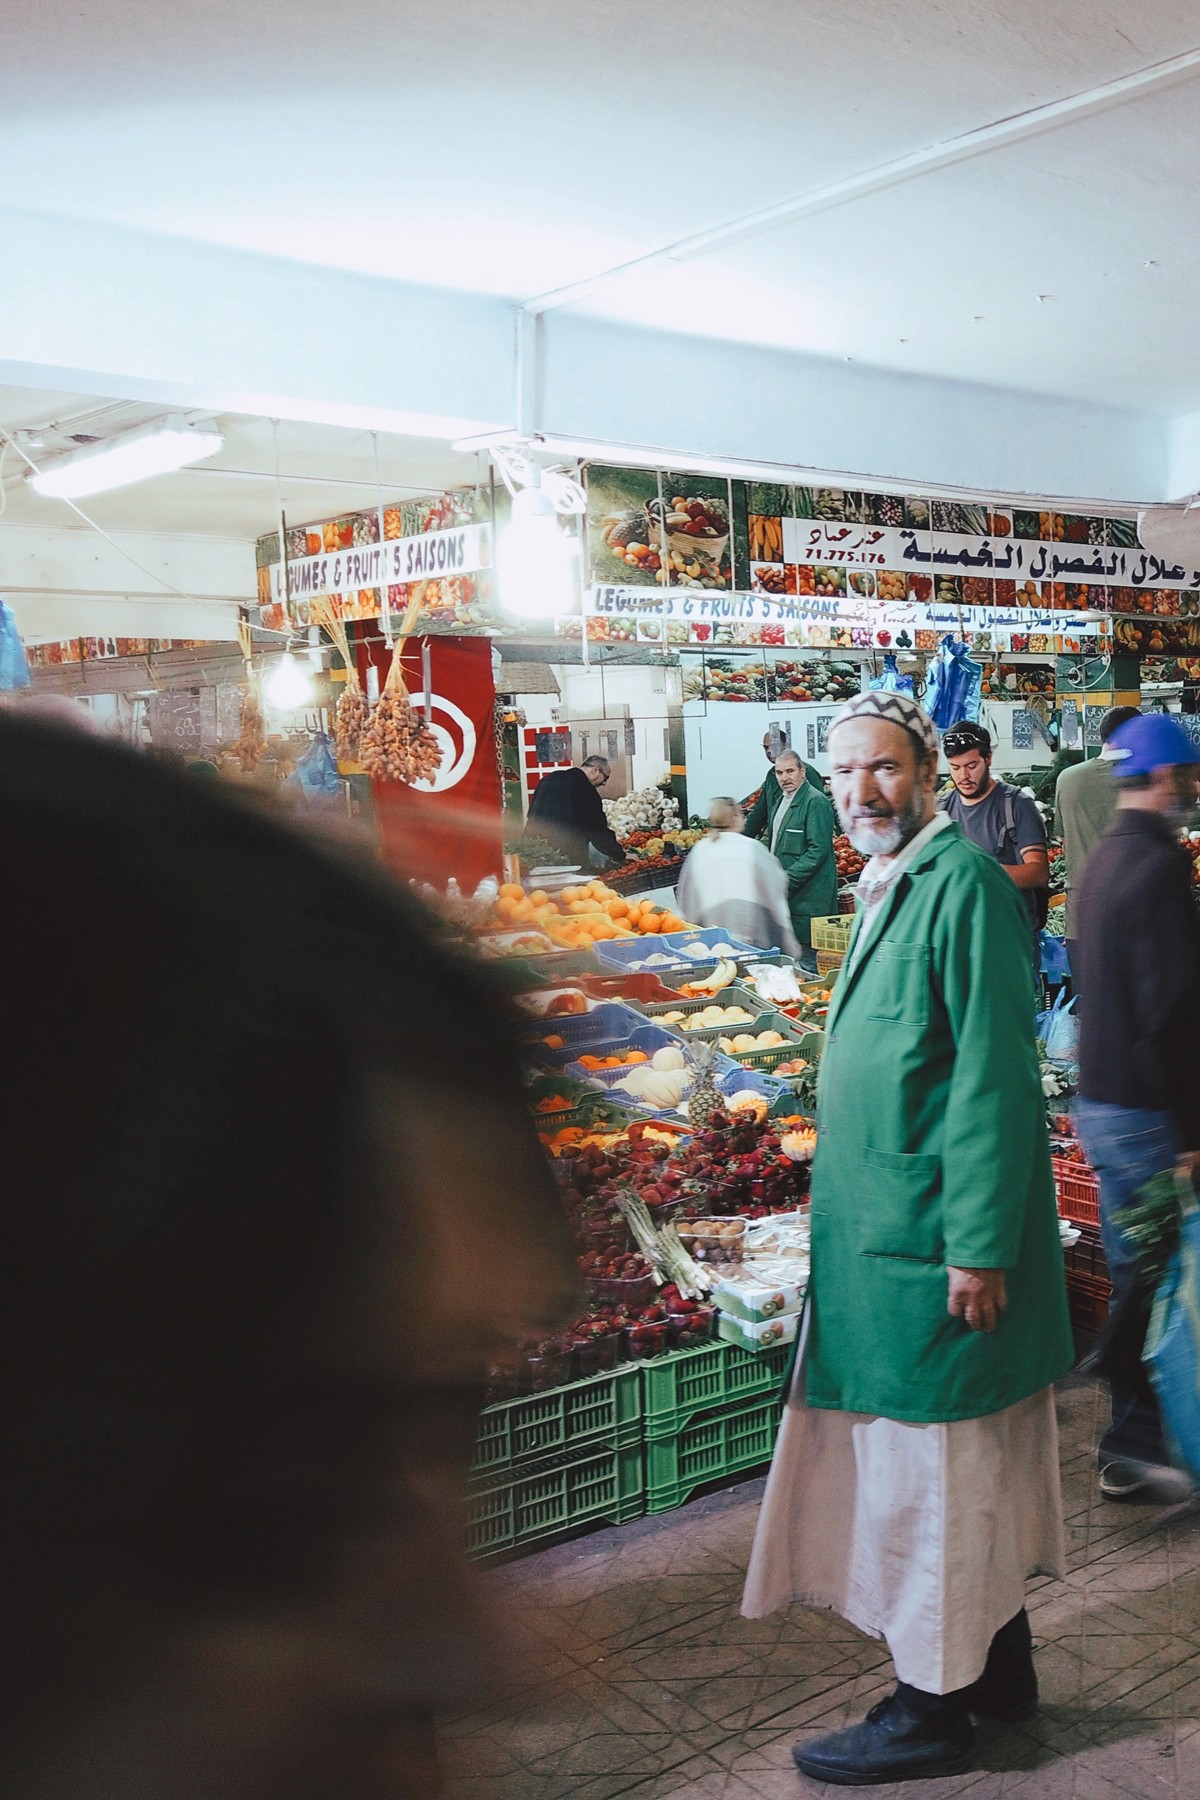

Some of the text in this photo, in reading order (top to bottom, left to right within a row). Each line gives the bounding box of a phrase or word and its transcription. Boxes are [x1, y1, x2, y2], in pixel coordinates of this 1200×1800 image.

[277, 560, 327, 598] LGUMES
[333, 557, 341, 587] &
[394, 546, 400, 577] 5
[407, 533, 464, 574] SAISONS
[805, 548, 885, 564] 71.775.176
[900, 530, 1022, 568] الخمسة
[1029, 545, 1126, 579] الفصول
[762, 597, 770, 617] 5
[777, 597, 840, 622] SAISONS
